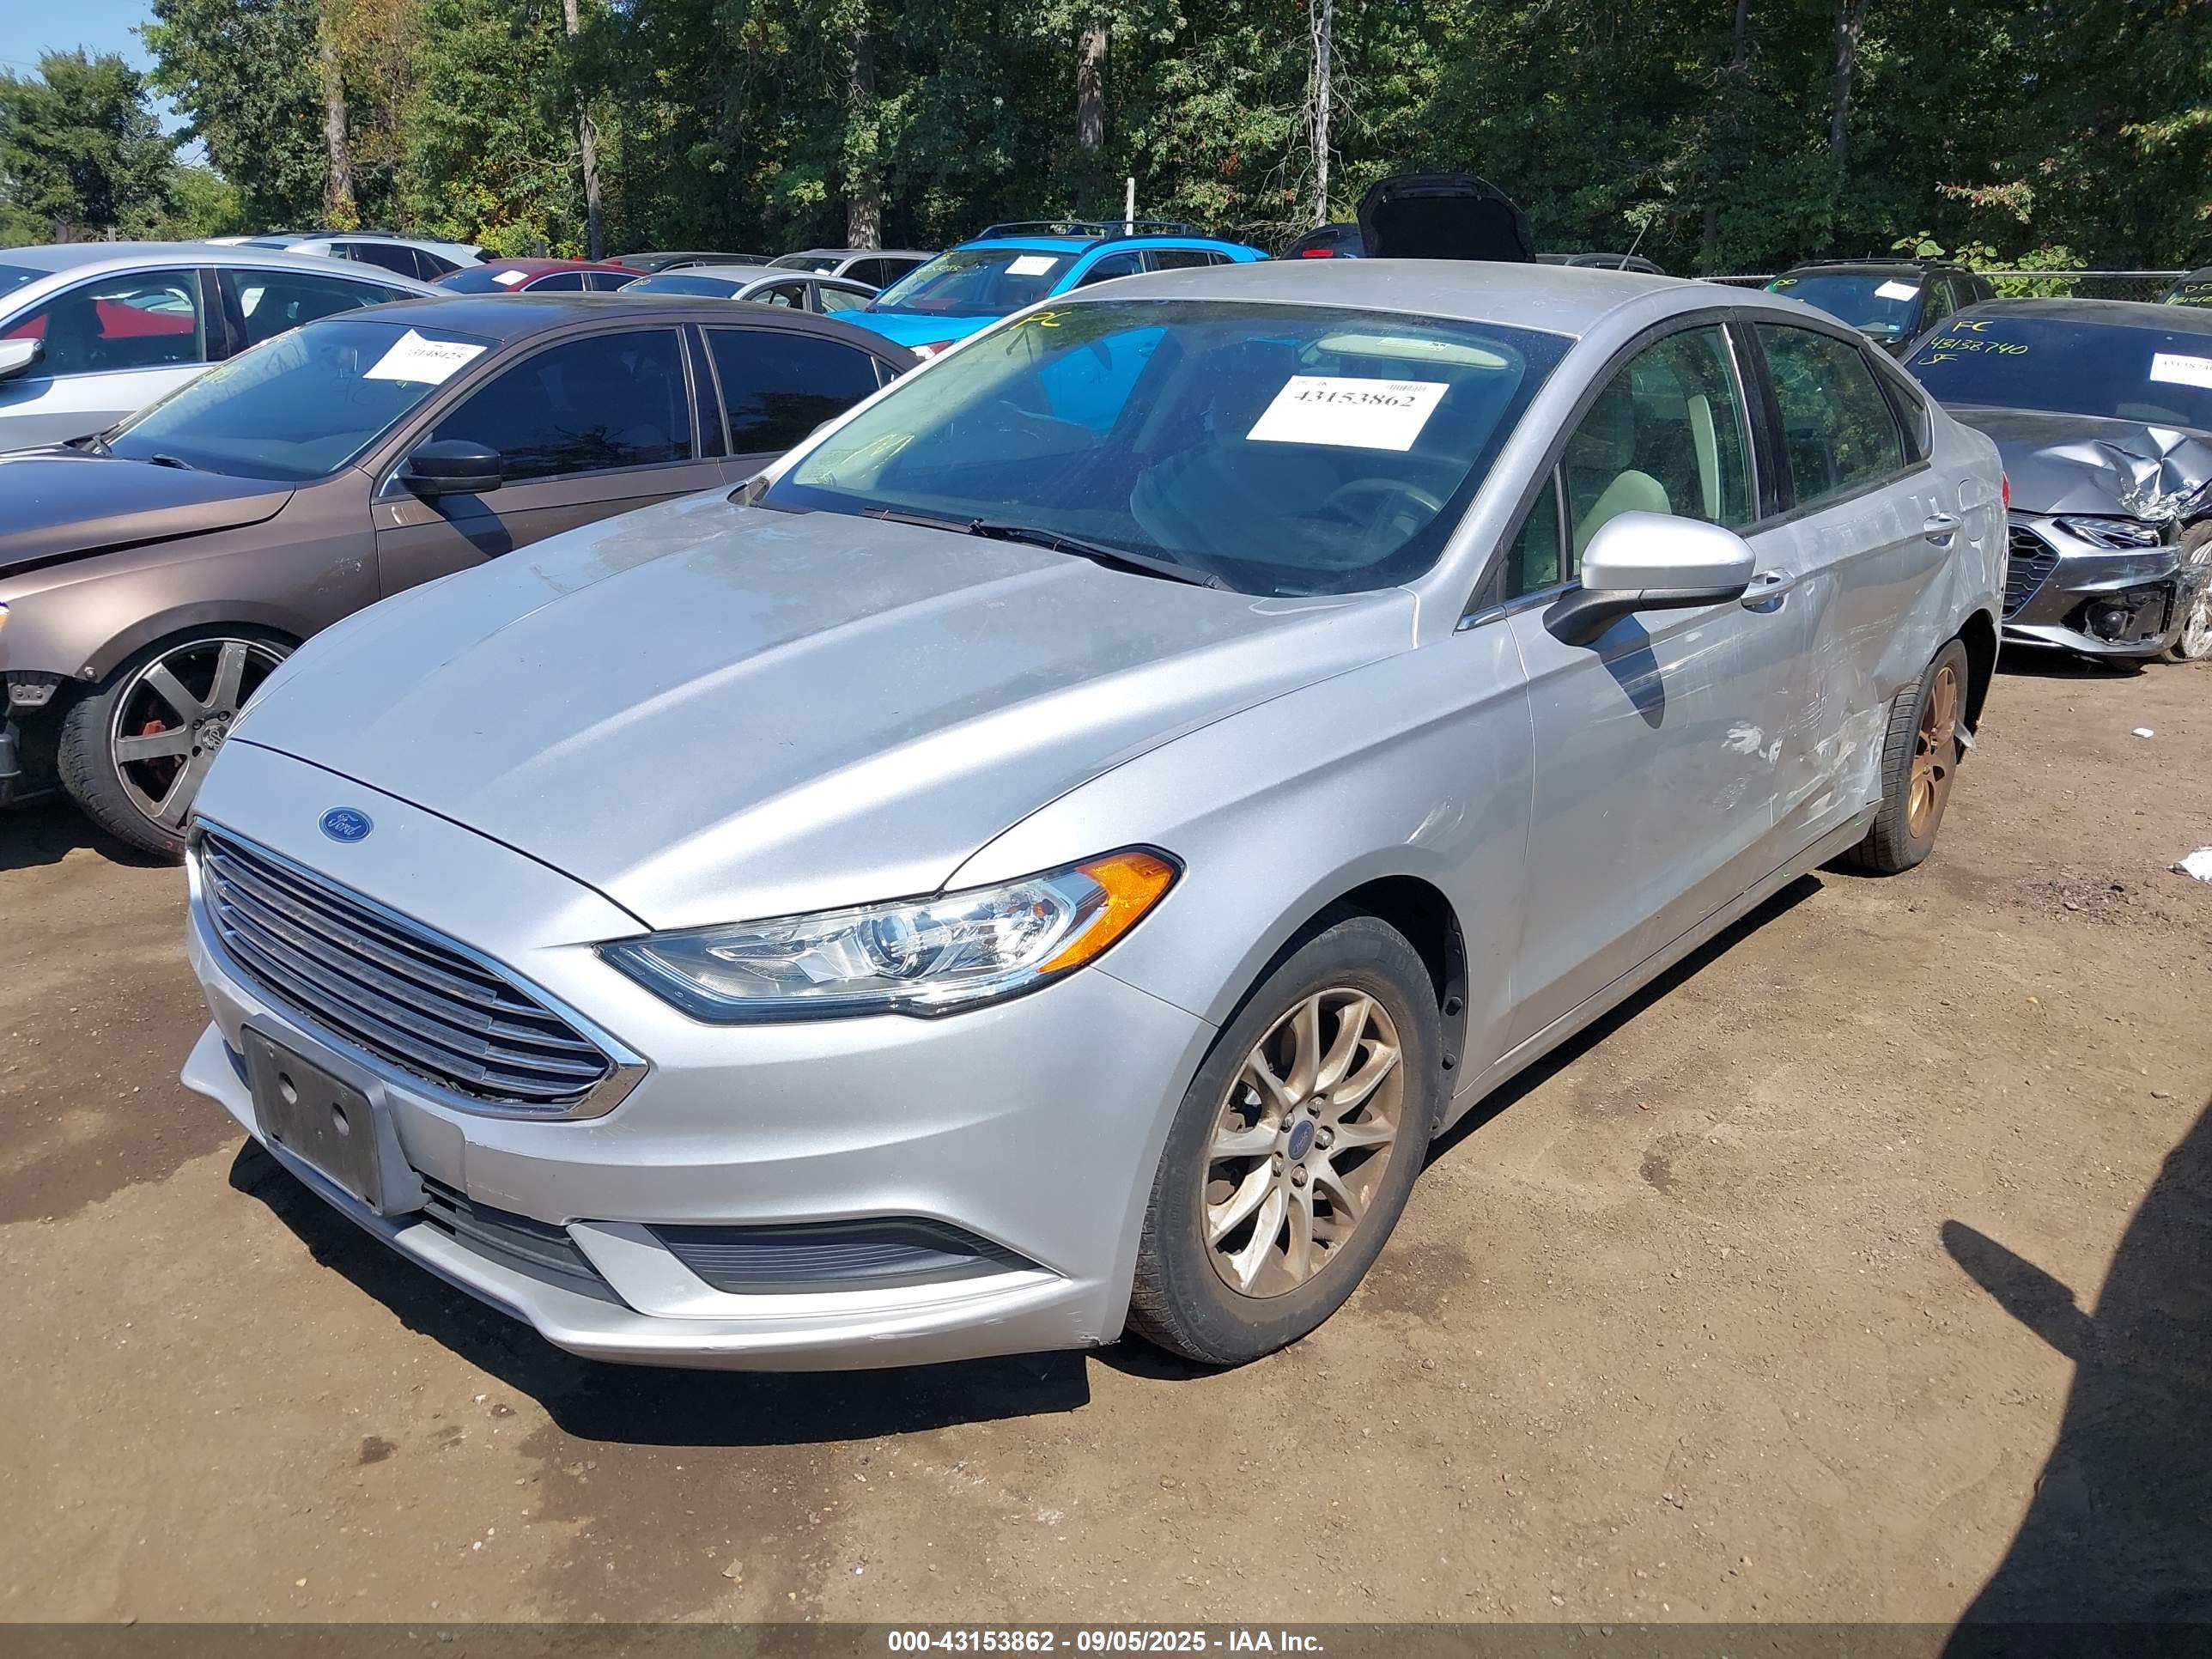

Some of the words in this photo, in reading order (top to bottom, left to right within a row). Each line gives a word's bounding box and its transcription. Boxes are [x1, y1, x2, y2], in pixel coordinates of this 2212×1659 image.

[1952, 320, 1994, 332] FC
[1930, 336, 2029, 355] 43138740
[1294, 390, 1416, 407] 43153862
[328, 812, 362, 836] Ford
